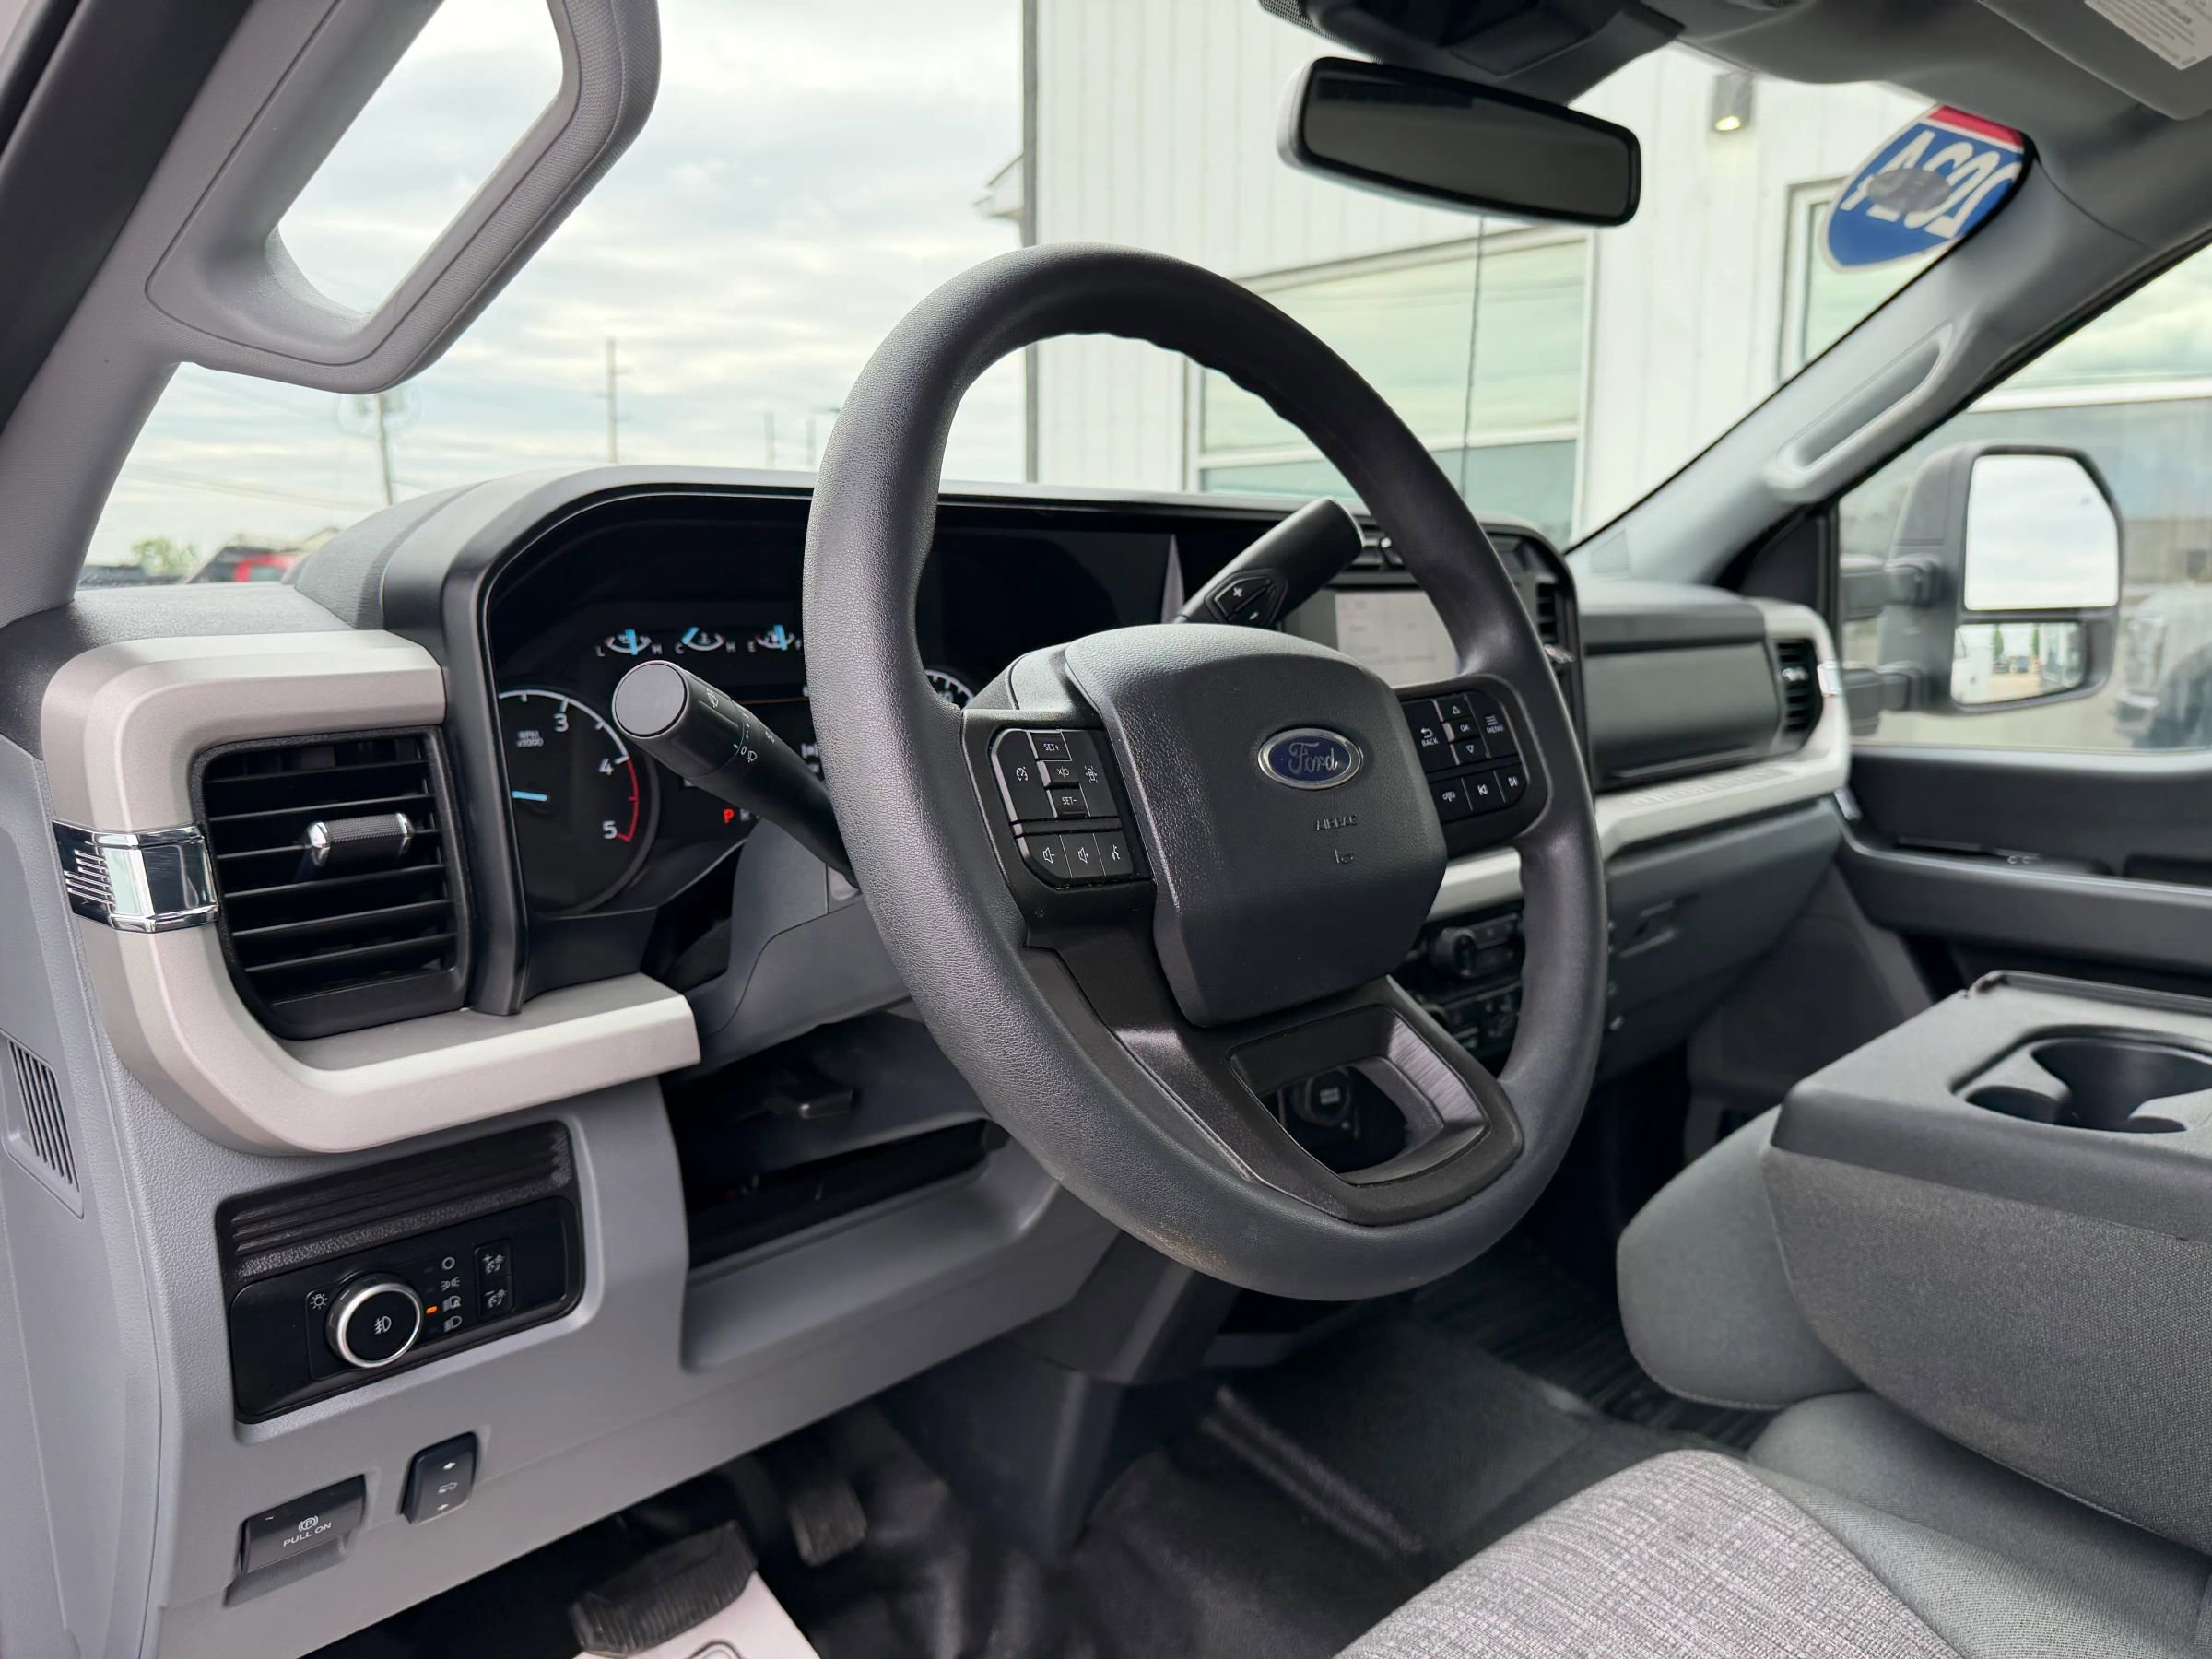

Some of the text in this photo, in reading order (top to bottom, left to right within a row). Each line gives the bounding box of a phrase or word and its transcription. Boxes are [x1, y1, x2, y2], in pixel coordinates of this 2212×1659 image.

[553, 713, 569, 732] 3
[1460, 723, 1470, 732] OK
[1486, 725, 1505, 735] MENU
[1420, 737, 1440, 747] BACK
[1288, 741, 1339, 775] Ford
[599, 759, 614, 776] 4
[723, 808, 735, 824] P
[602, 819, 618, 840] 5
[283, 1522, 333, 1547] PULL ON
